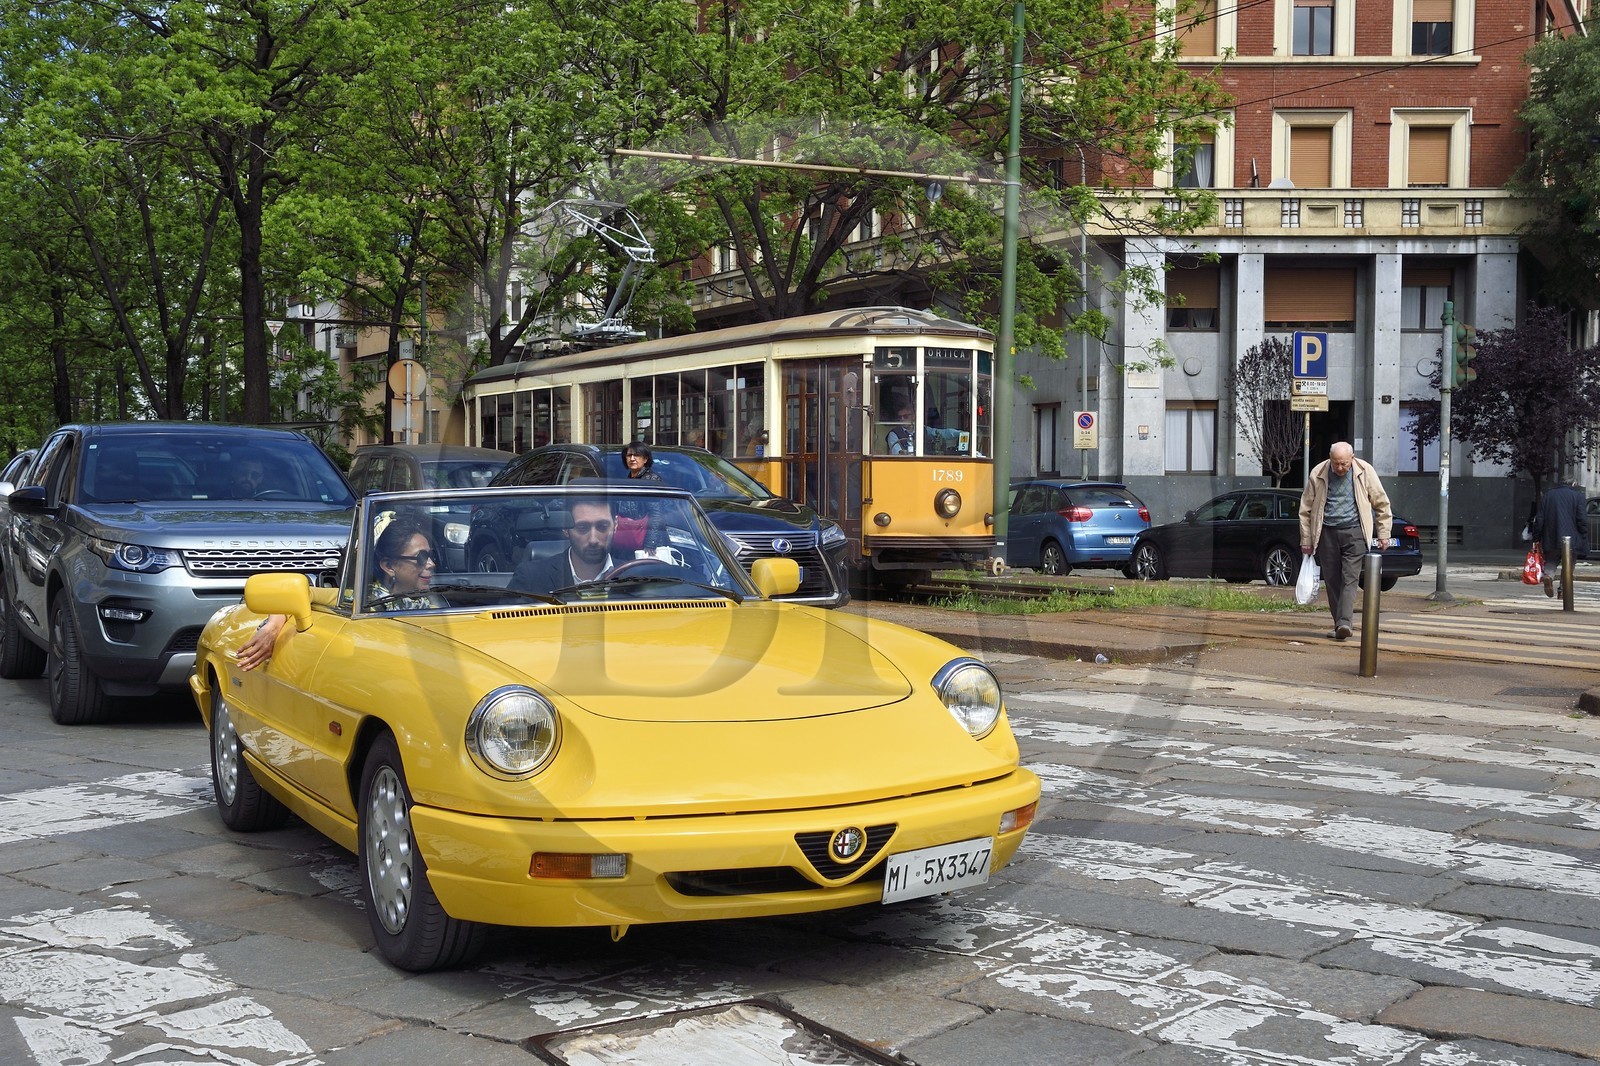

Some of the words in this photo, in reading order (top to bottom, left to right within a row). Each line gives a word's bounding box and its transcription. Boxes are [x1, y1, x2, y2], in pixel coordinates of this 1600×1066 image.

[887, 349, 903, 368] 5
[928, 349, 965, 358] ORTICA
[1301, 336, 1322, 374] P
[932, 469, 963, 481] 1789
[203, 540, 339, 548] DISCOVERY
[834, 831, 846, 847] ALFA
[887, 864, 909, 893] MI
[924, 849, 991, 884] 5X3347
